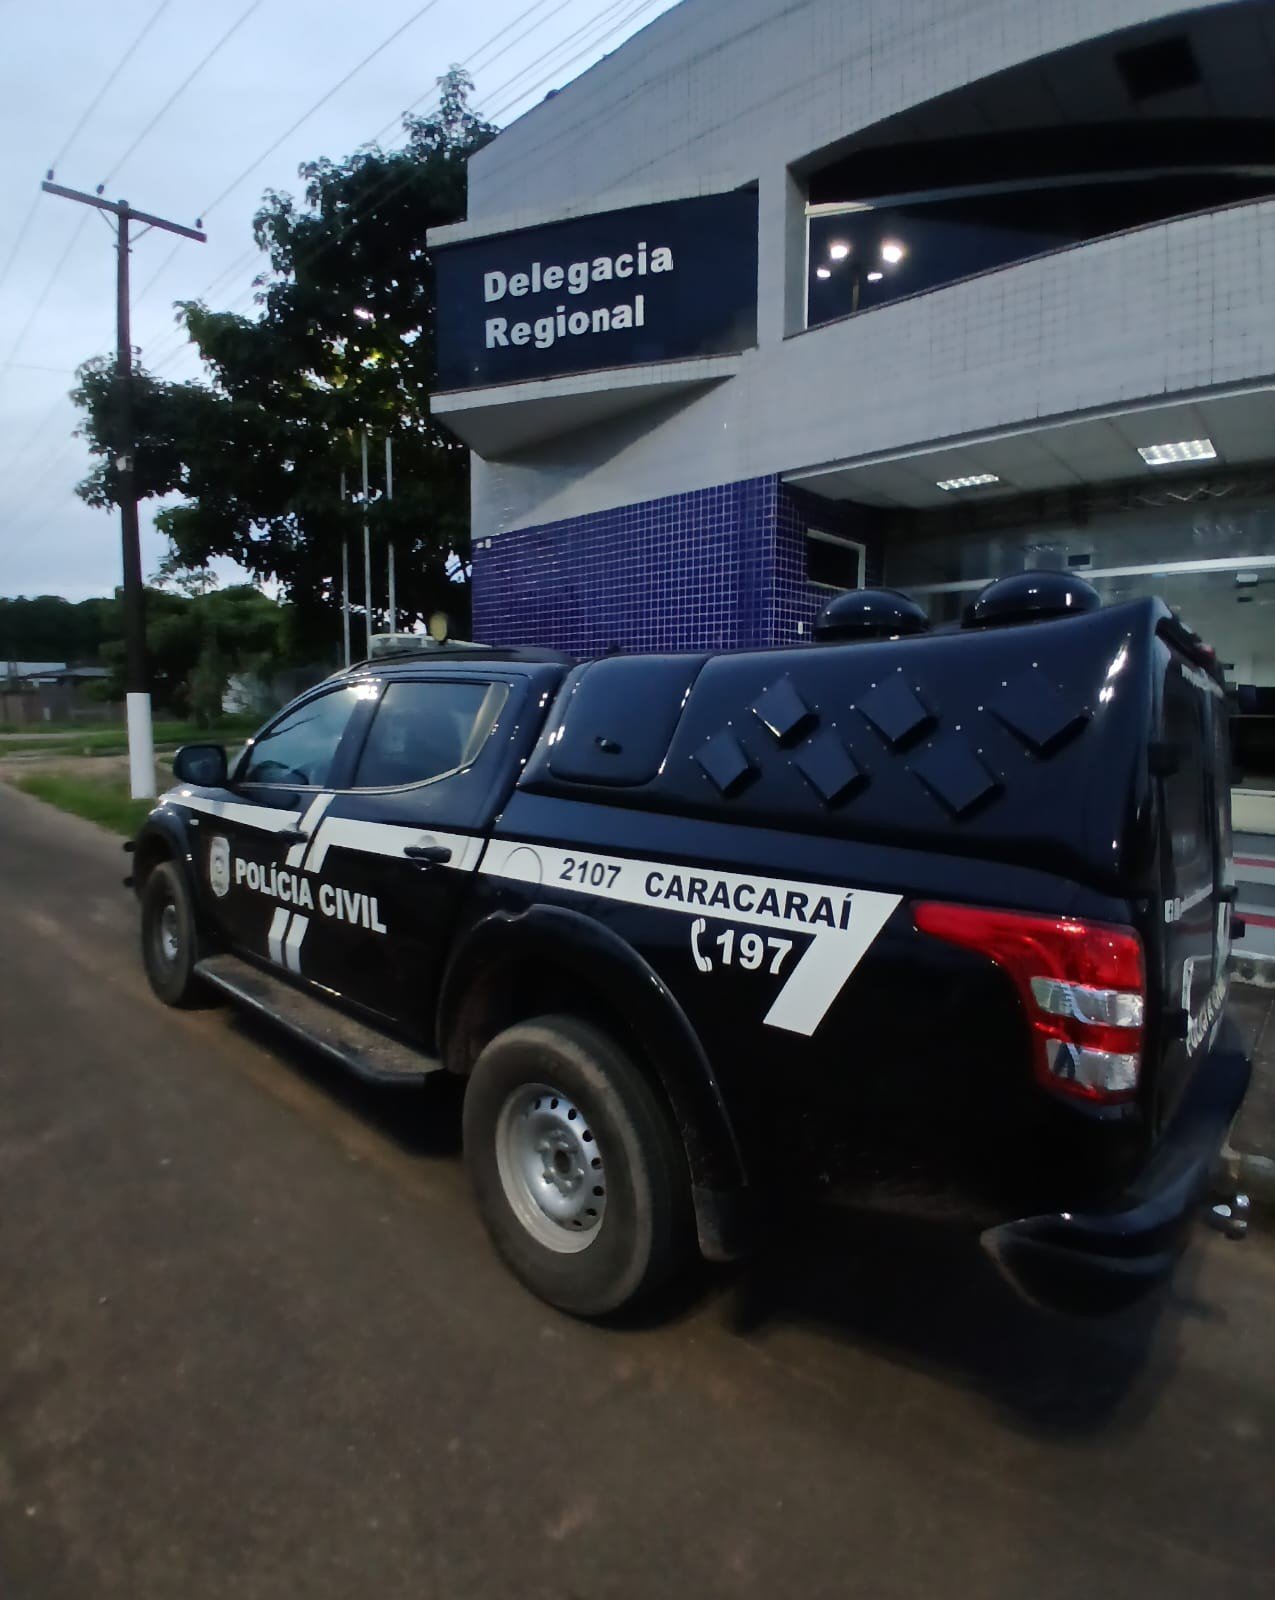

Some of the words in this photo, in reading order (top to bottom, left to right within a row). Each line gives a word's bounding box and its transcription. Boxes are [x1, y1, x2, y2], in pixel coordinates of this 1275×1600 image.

[483, 241, 674, 302] Delegacia
[485, 295, 644, 349] Regional
[235, 857, 314, 909] POLÍCIA
[319, 884, 387, 934] CIVIL
[559, 858, 622, 889] 2107
[644, 871, 853, 931] CARACARAÍ
[715, 929, 793, 974] 197
